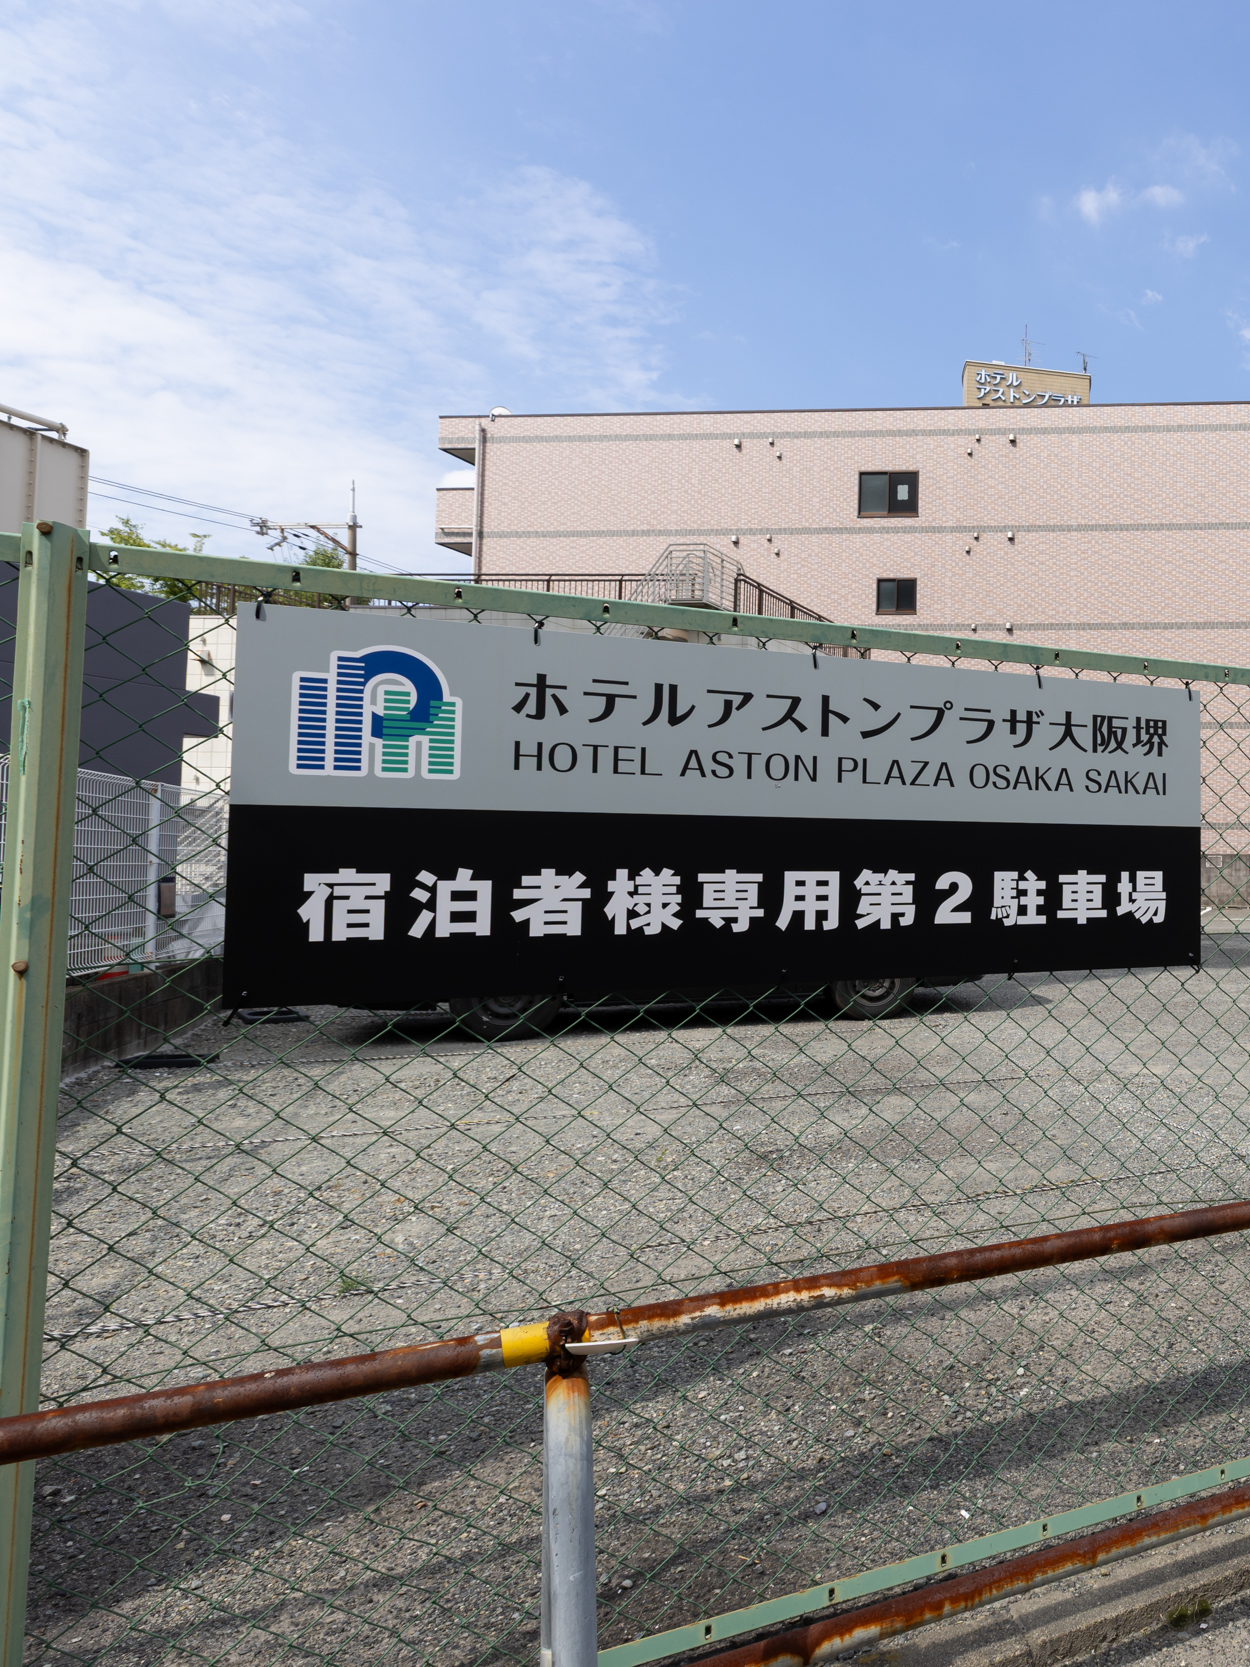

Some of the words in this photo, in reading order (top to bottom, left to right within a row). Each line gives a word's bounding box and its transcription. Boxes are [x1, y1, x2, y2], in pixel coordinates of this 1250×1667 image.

[976, 369, 1021, 387] ホテル
[976, 385, 1082, 405] アストンプラザ
[511, 673, 1169, 758] ホテルアストンプラザ大阪堺
[513, 740, 663, 776] HOTEL
[679, 748, 818, 783] ASTON
[837, 756, 955, 788] PLAZA
[968, 763, 1075, 792] OSAKA
[1084, 768, 1167, 796] SAKAI
[296, 867, 1167, 942] 宿泊者様専用第2駐車場
